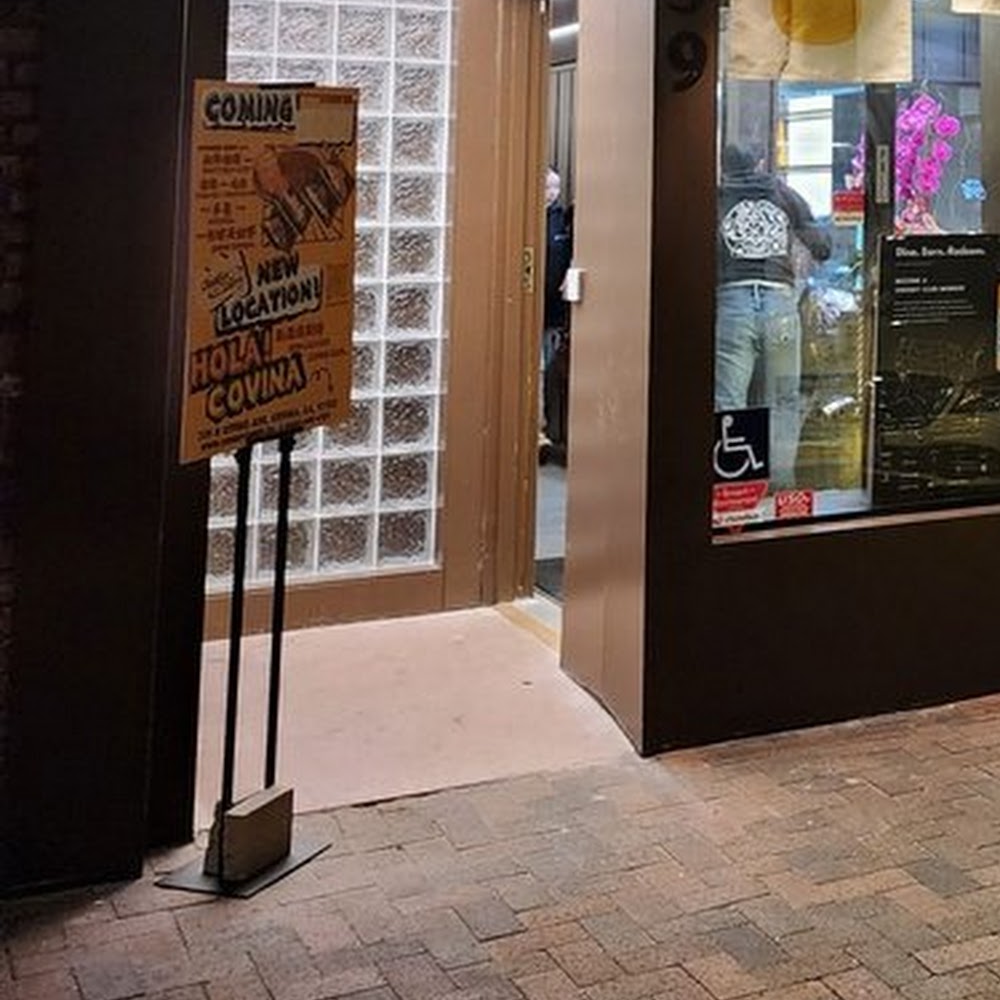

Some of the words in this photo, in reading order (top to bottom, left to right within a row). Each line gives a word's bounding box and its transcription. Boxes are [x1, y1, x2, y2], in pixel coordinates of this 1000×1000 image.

[204, 92, 295, 124] COMING
[256, 254, 300, 287] NEW
[220, 275, 321, 328] LOCATION!
